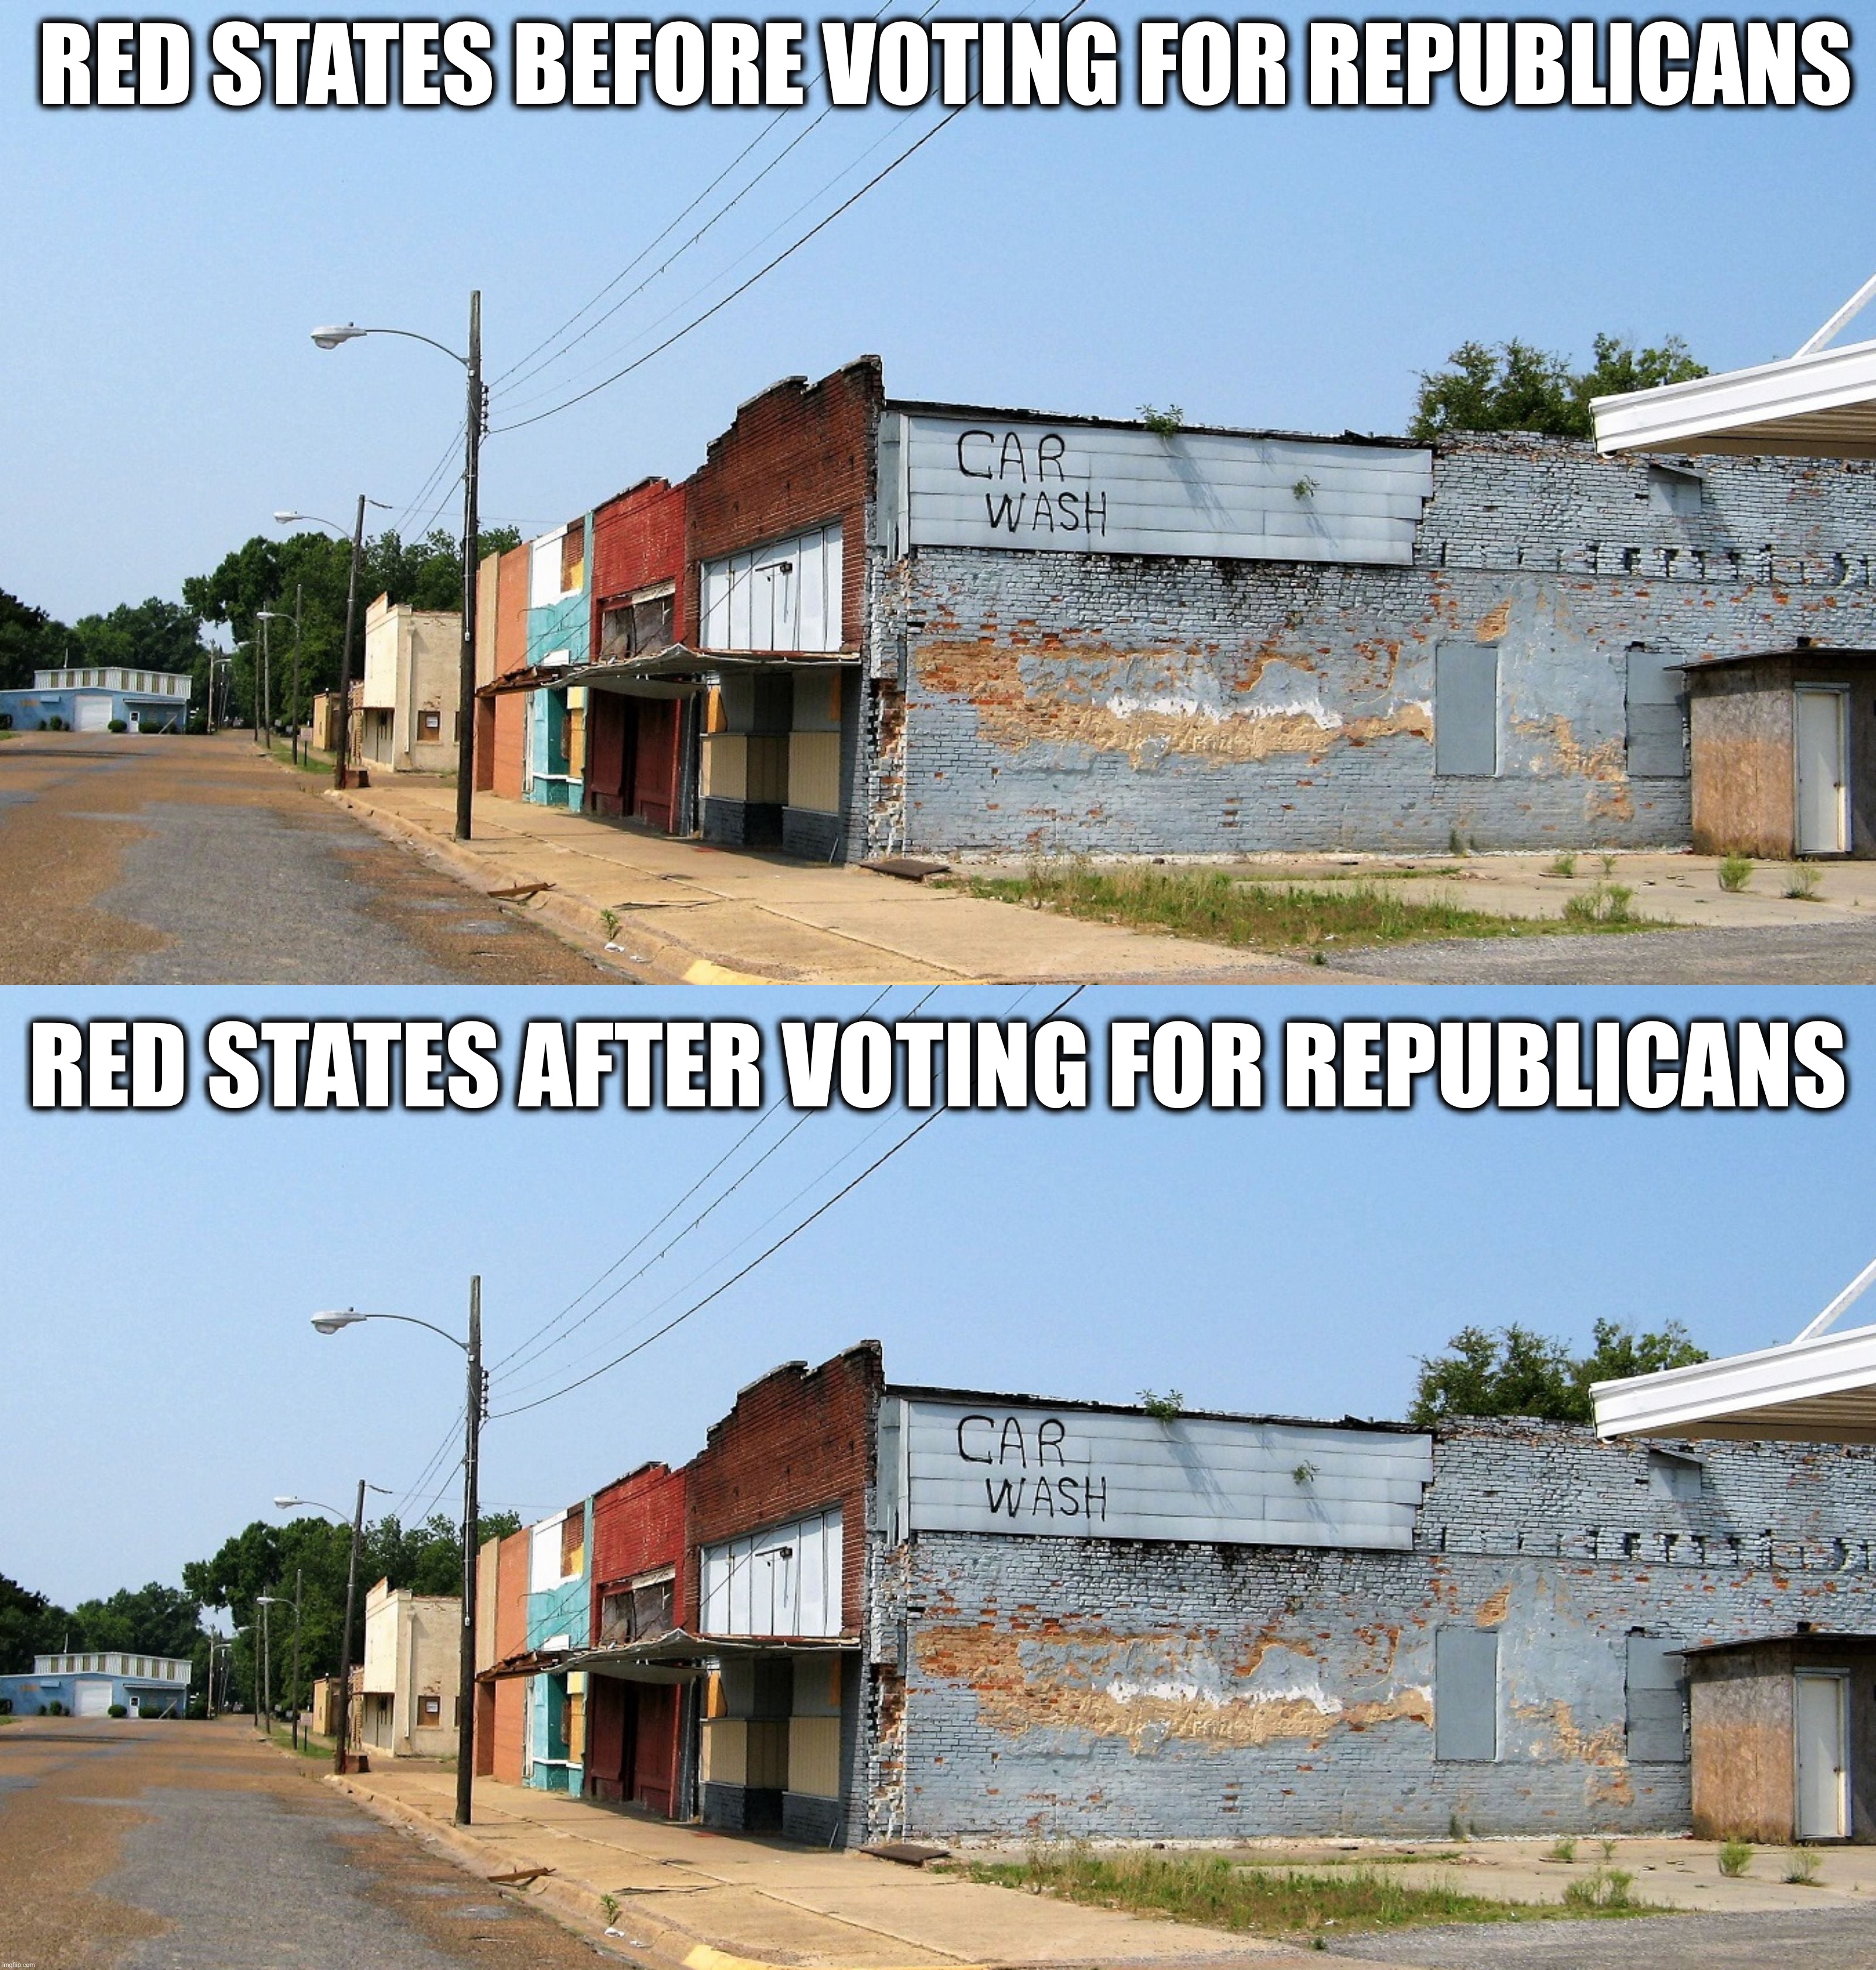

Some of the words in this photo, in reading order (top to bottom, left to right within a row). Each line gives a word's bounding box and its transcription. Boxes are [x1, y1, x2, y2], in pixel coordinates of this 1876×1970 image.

[956, 429, 1066, 484] CAR
[985, 491, 1107, 537] WASH
[956, 1414, 1066, 1469] CAR
[985, 1476, 1107, 1522] WASH
